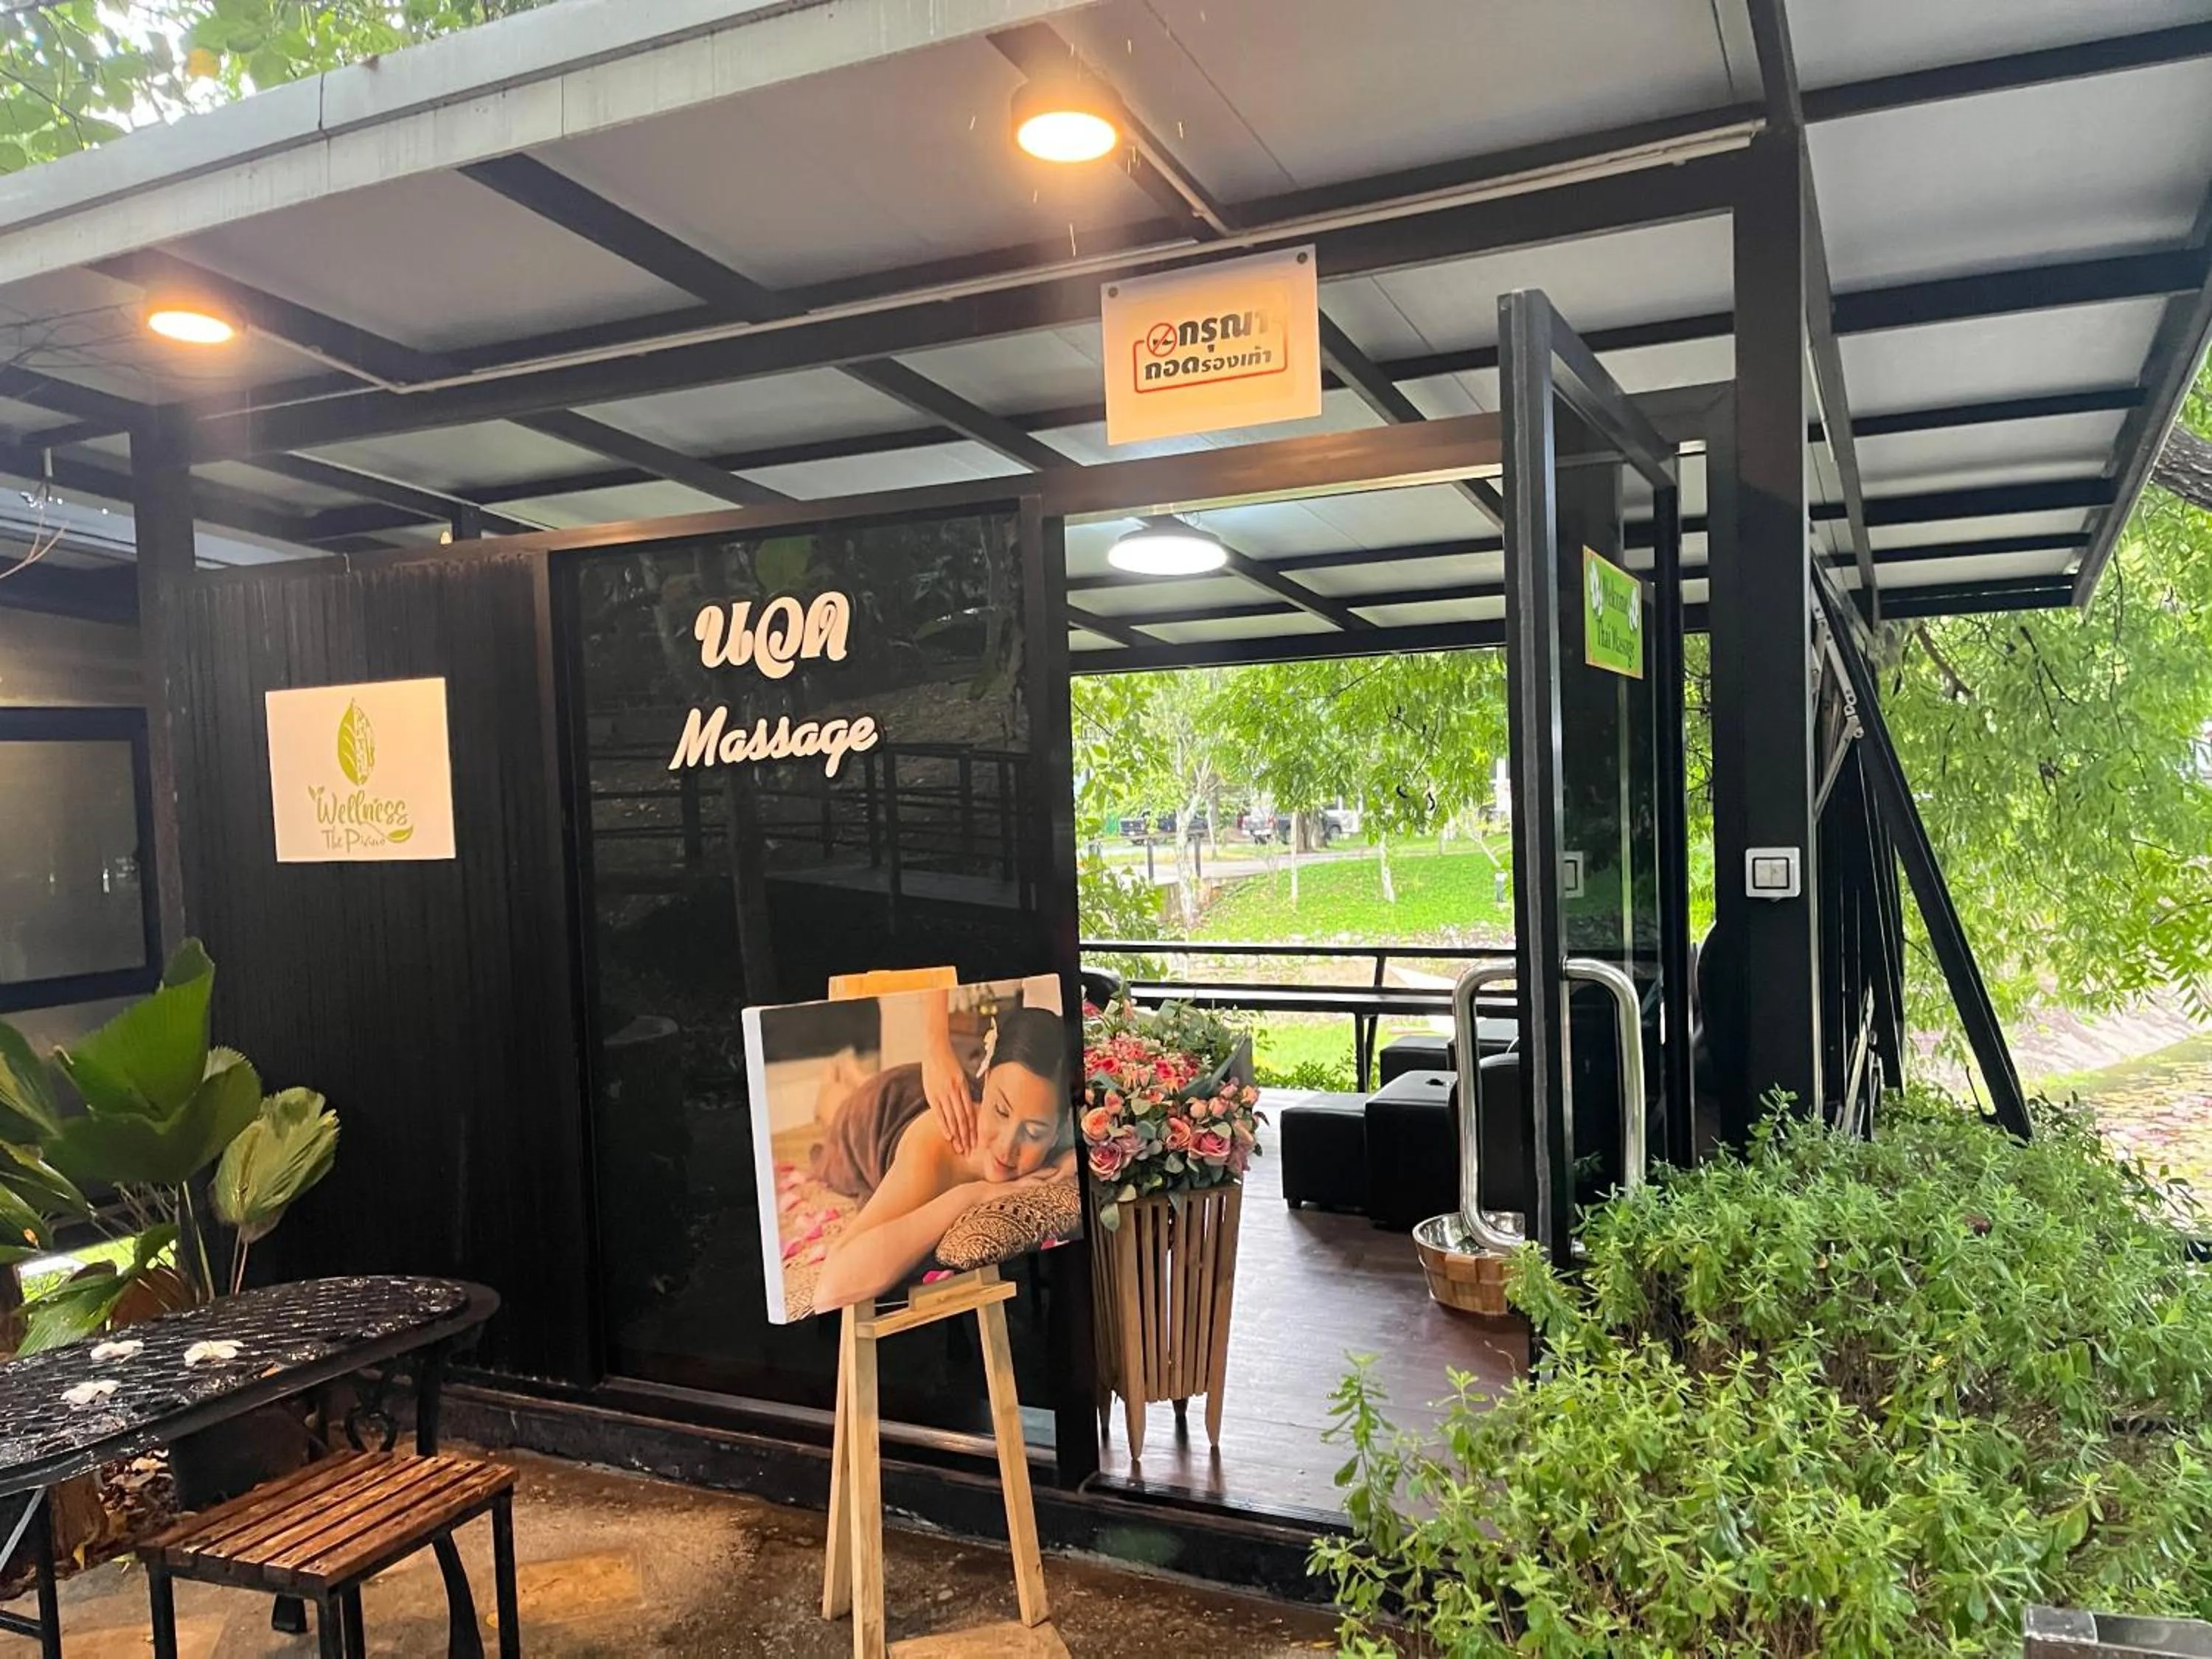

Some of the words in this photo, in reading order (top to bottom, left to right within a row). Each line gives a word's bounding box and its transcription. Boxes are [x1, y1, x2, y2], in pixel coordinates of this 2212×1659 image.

[694, 591, 850, 679] นวด
[668, 706, 878, 778] Massage
[316, 790, 408, 826] Wellness
